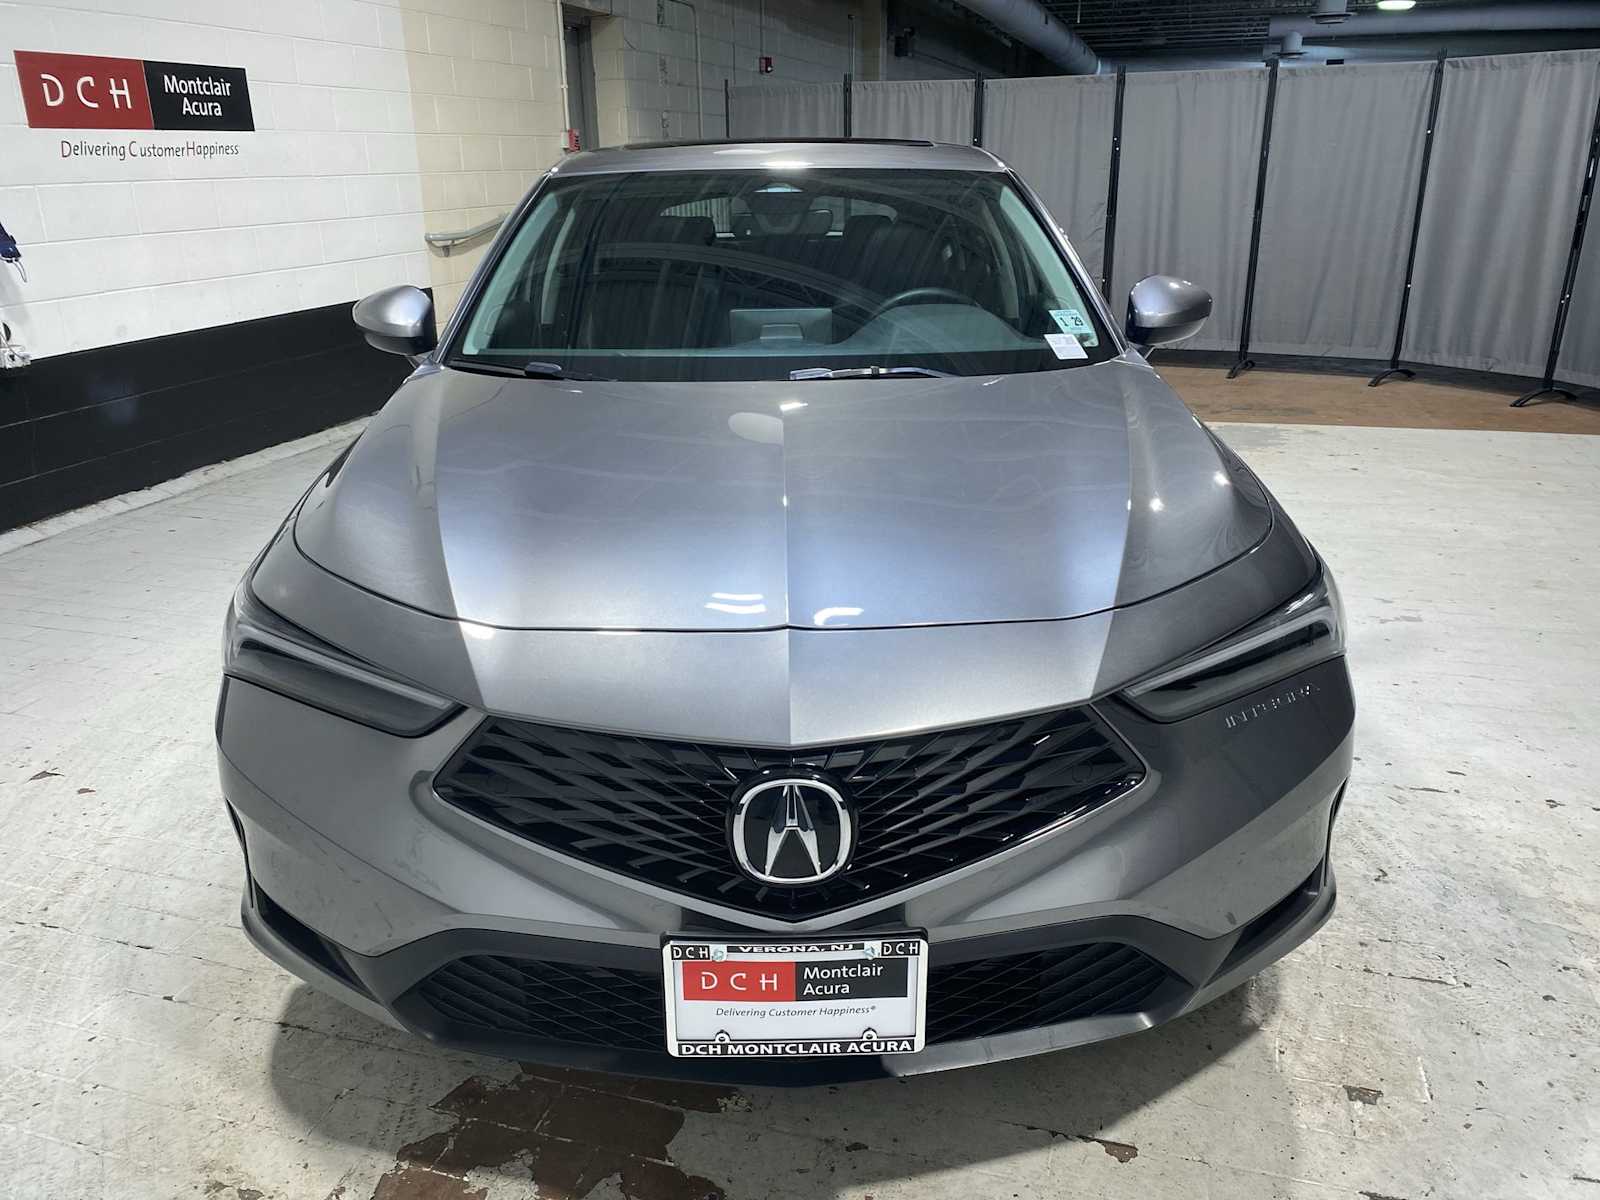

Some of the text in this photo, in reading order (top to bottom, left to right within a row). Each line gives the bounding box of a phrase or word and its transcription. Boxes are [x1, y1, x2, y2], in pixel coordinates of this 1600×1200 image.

[40, 73, 133, 109] DCH
[163, 74, 231, 97] Montclair
[182, 97, 223, 117] Acura
[61, 140, 240, 161] Delivering Customer Happiness
[673, 945, 710, 959] DCH
[738, 943, 853, 954] VERONA, NJ
[883, 942, 919, 955] DCH
[803, 963, 884, 980] Montclair
[701, 971, 778, 991] DCH
[803, 981, 850, 996] Acura
[715, 1007, 767, 1019] Delivering
[768, 1007, 817, 1017] Customer
[681, 1040, 912, 1056] DCH MONTCLAIR ACURA
